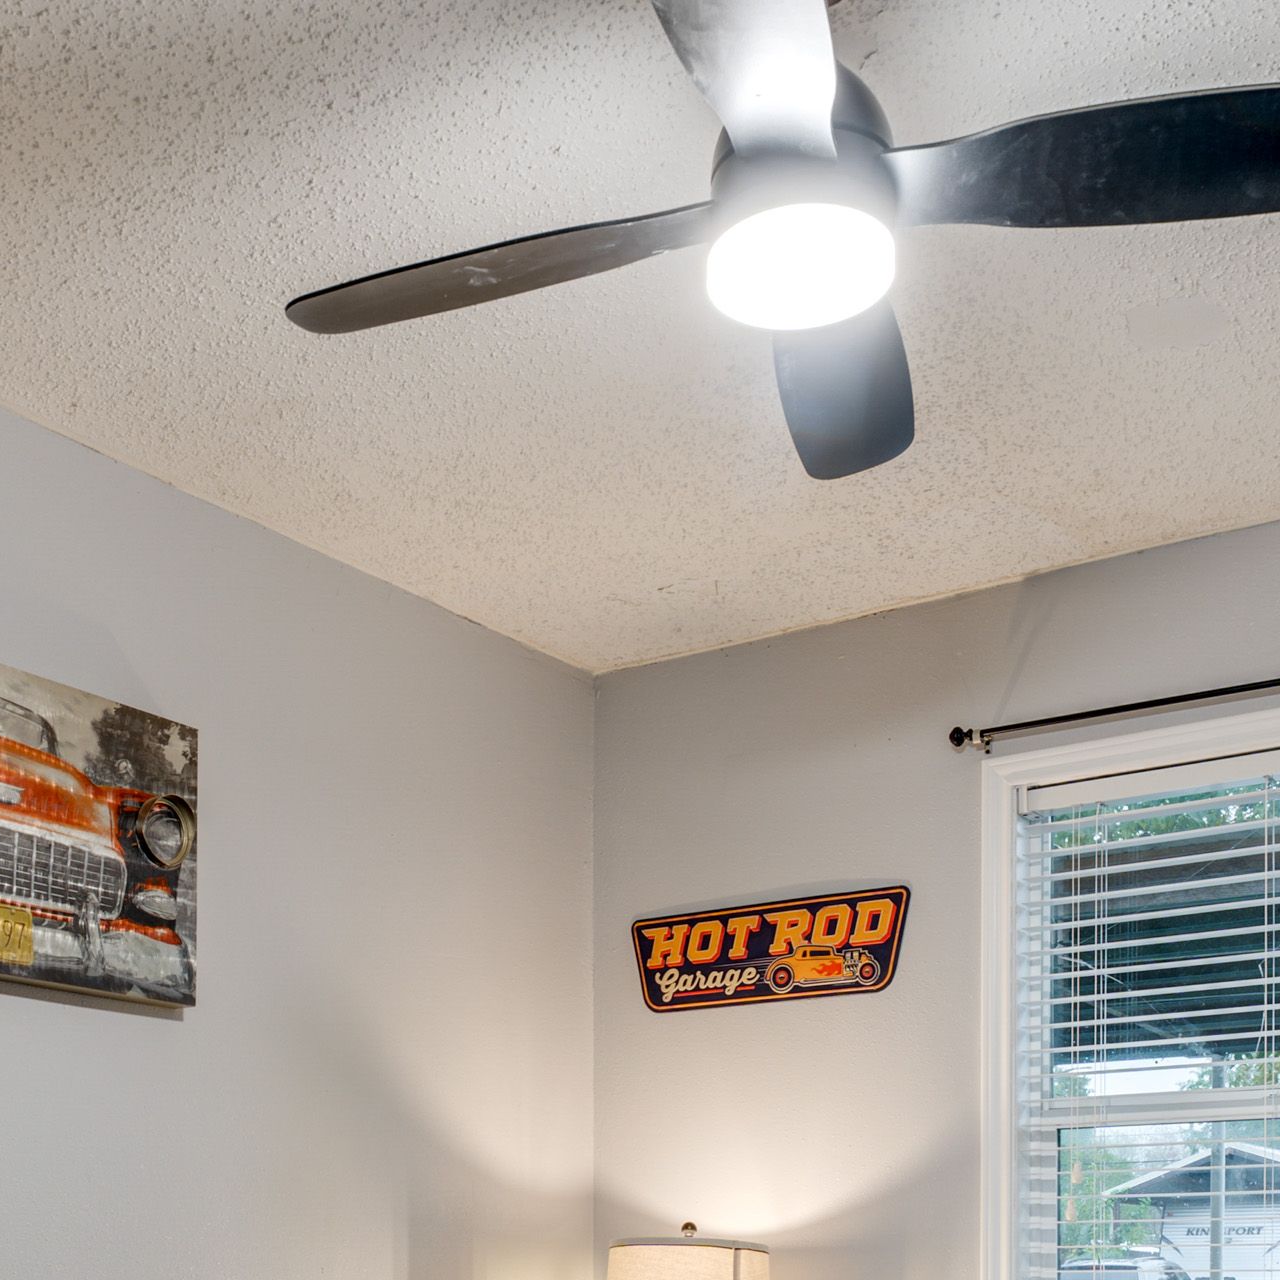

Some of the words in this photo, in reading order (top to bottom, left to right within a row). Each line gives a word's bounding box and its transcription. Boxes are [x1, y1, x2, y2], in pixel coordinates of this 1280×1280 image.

[641, 915, 763, 969] HOT
[763, 898, 897, 956] ROD
[655, 966, 760, 1003] Garage
[1186, 1226, 1264, 1236] KINPORT
